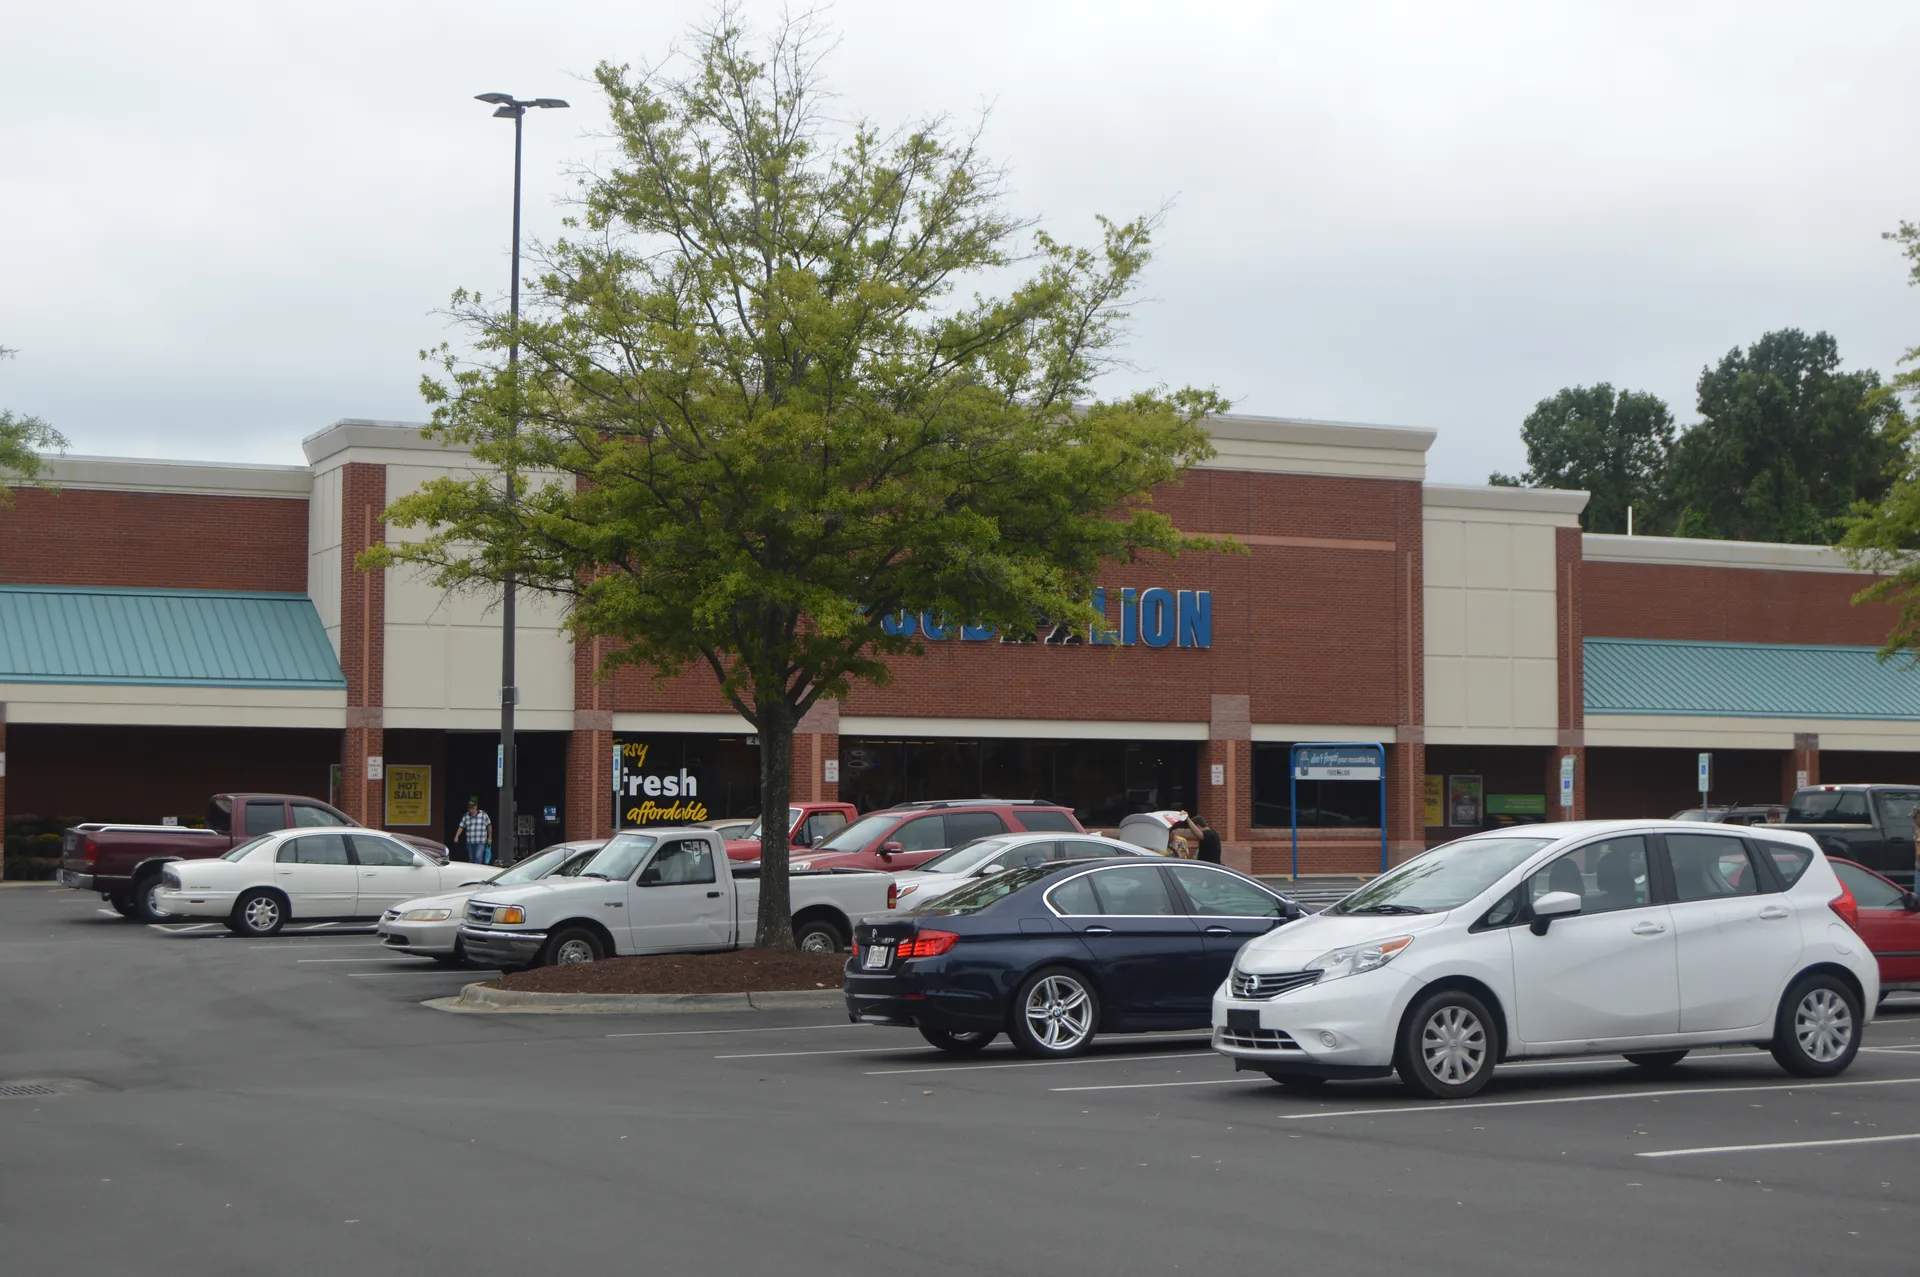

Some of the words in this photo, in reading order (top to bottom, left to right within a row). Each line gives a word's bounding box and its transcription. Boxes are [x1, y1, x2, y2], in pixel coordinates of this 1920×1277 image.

[1089, 586, 1211, 648] LION
[396, 772, 403, 781] 3
[405, 772, 422, 781] DAY
[398, 782, 419, 791] HOT
[394, 790, 423, 800] SALE!
[626, 800, 708, 824] affordable
